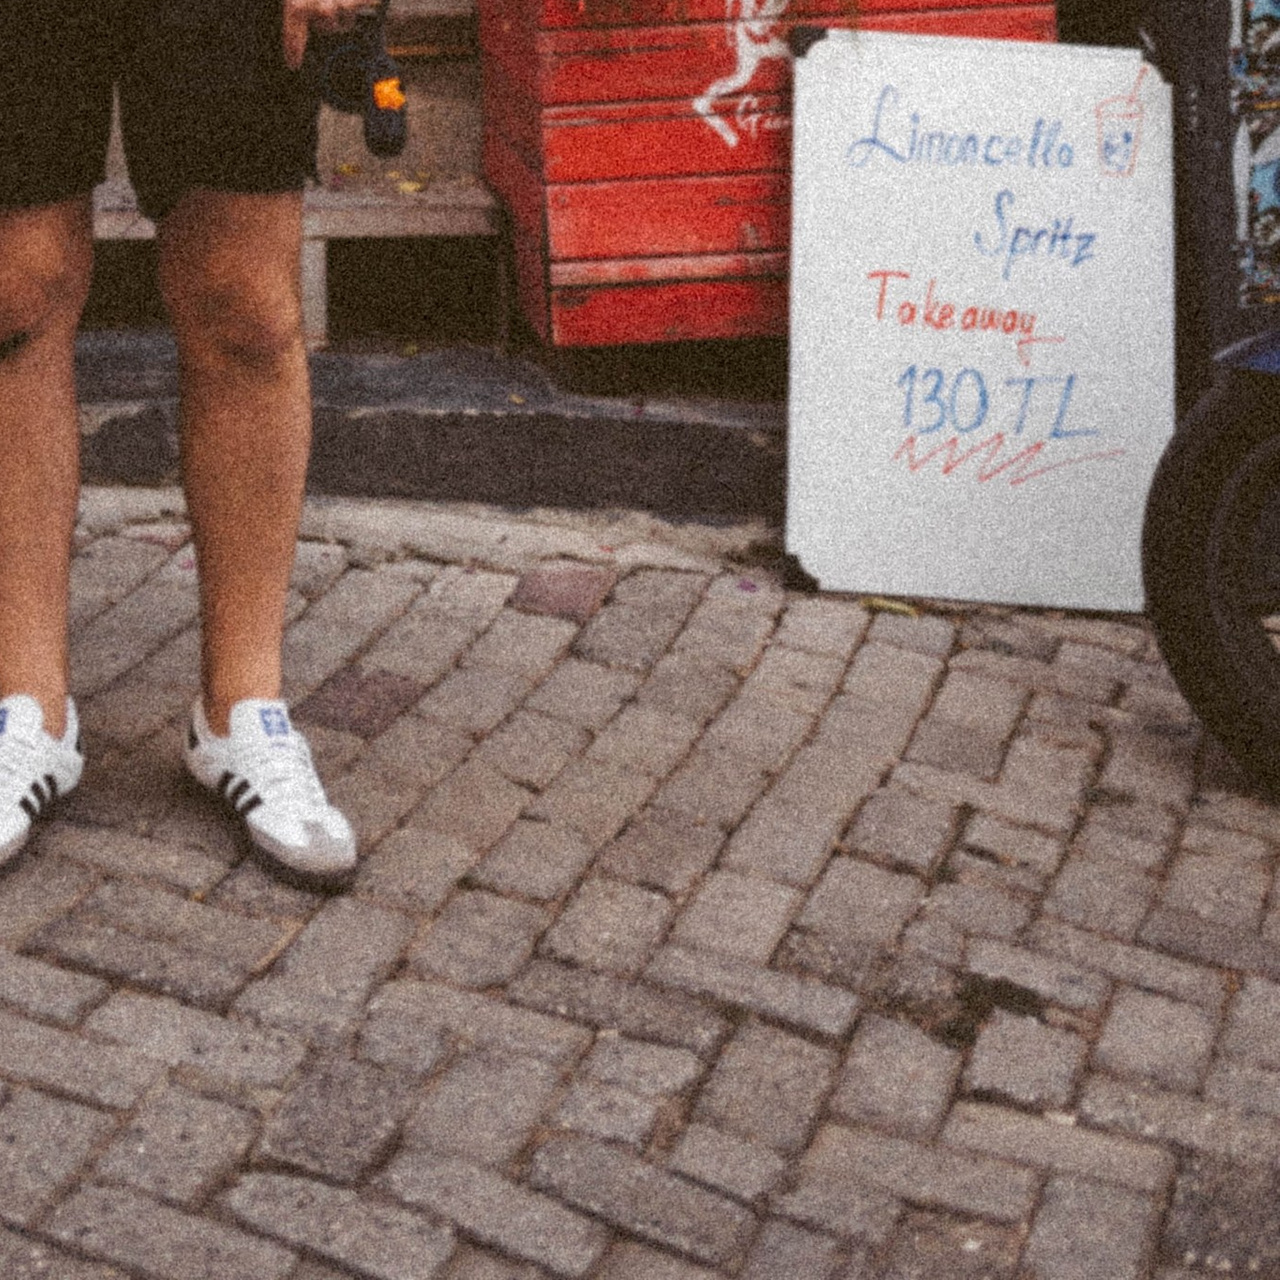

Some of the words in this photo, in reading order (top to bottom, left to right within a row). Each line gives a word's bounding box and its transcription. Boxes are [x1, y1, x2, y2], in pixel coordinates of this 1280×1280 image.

[846, 84, 1075, 170] Limoncello
[973, 190, 1098, 279] Spritz
[896, 364, 990, 435] 130
[1005, 374, 1099, 440] TL
